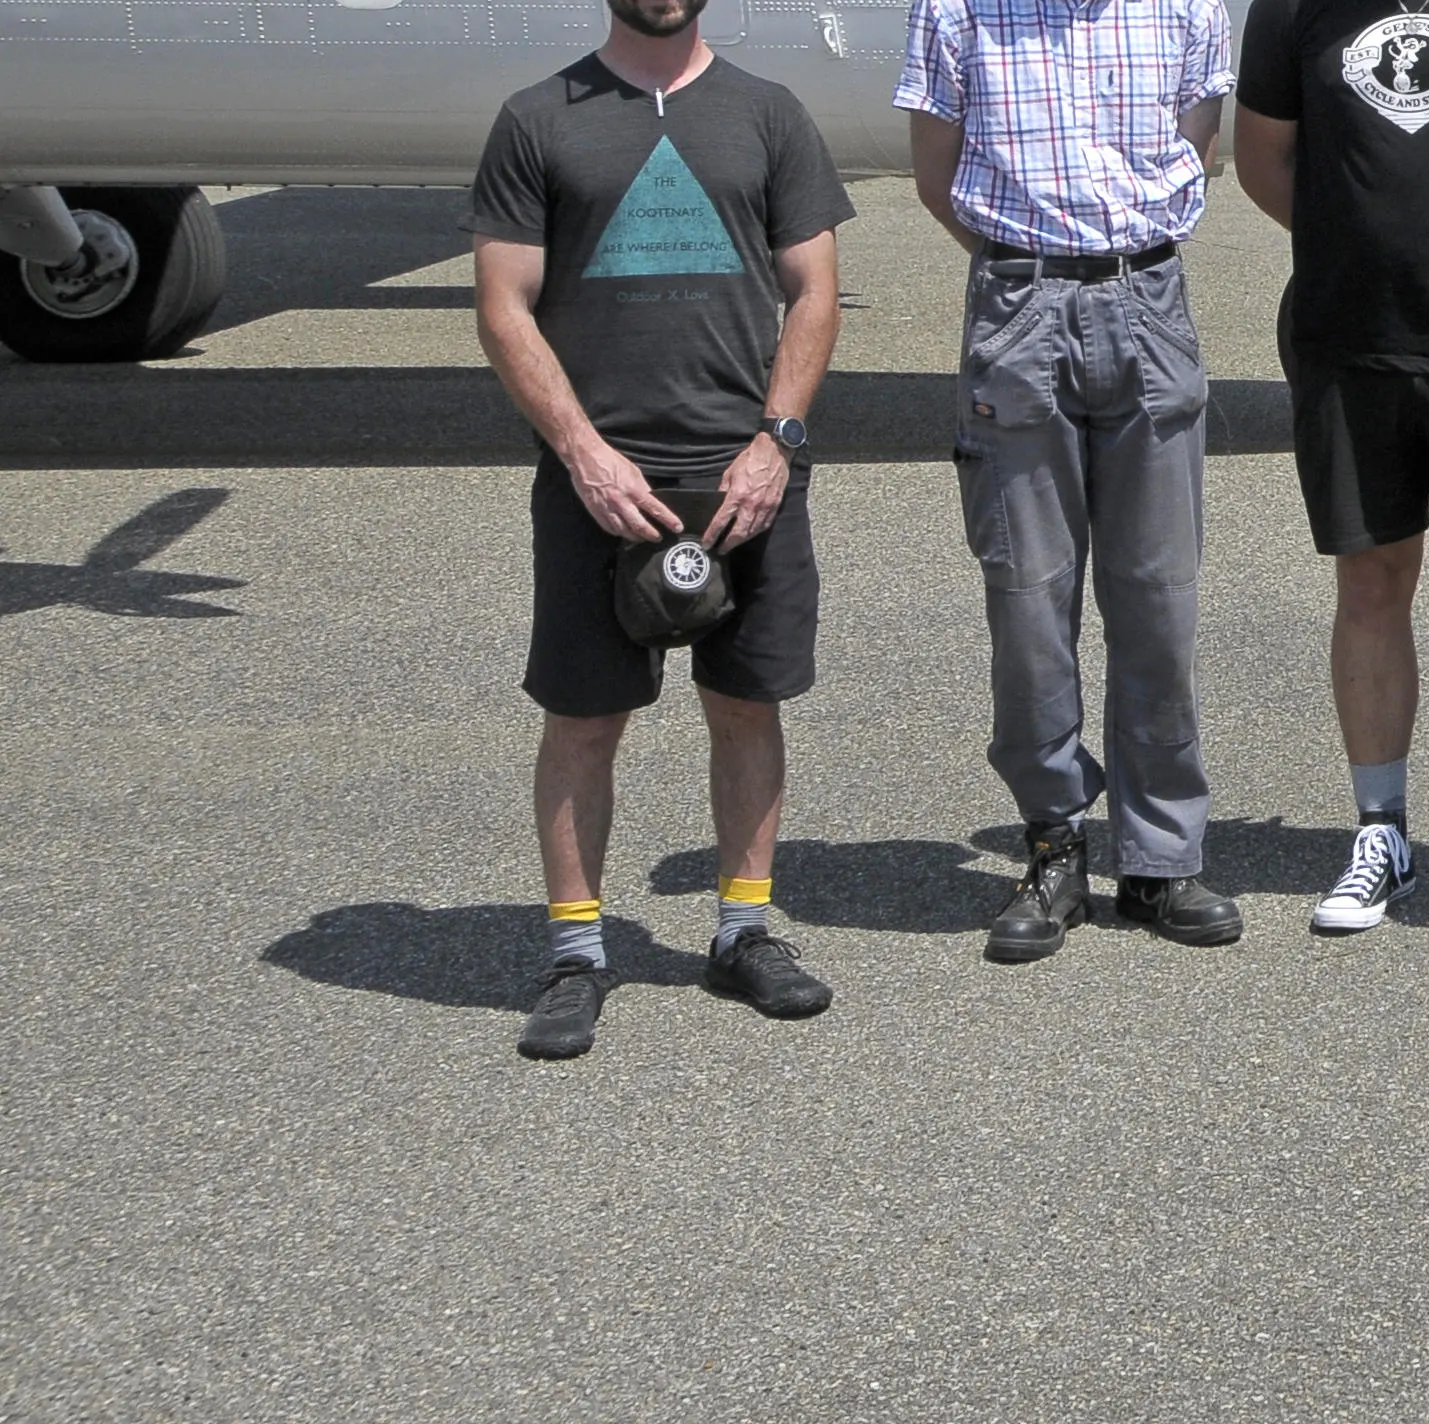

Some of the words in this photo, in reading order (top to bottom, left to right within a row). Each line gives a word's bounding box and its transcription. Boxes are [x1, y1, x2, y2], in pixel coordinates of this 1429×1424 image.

[1364, 82, 1396, 106] CYCLE
[1396, 98, 1420, 108] AND
[654, 176, 677, 188] THE
[627, 207, 704, 219] KOOTENAYS
[603, 243, 623, 254] ARE
[627, 242, 670, 253] WHERE
[680, 241, 728, 252] BELONG
